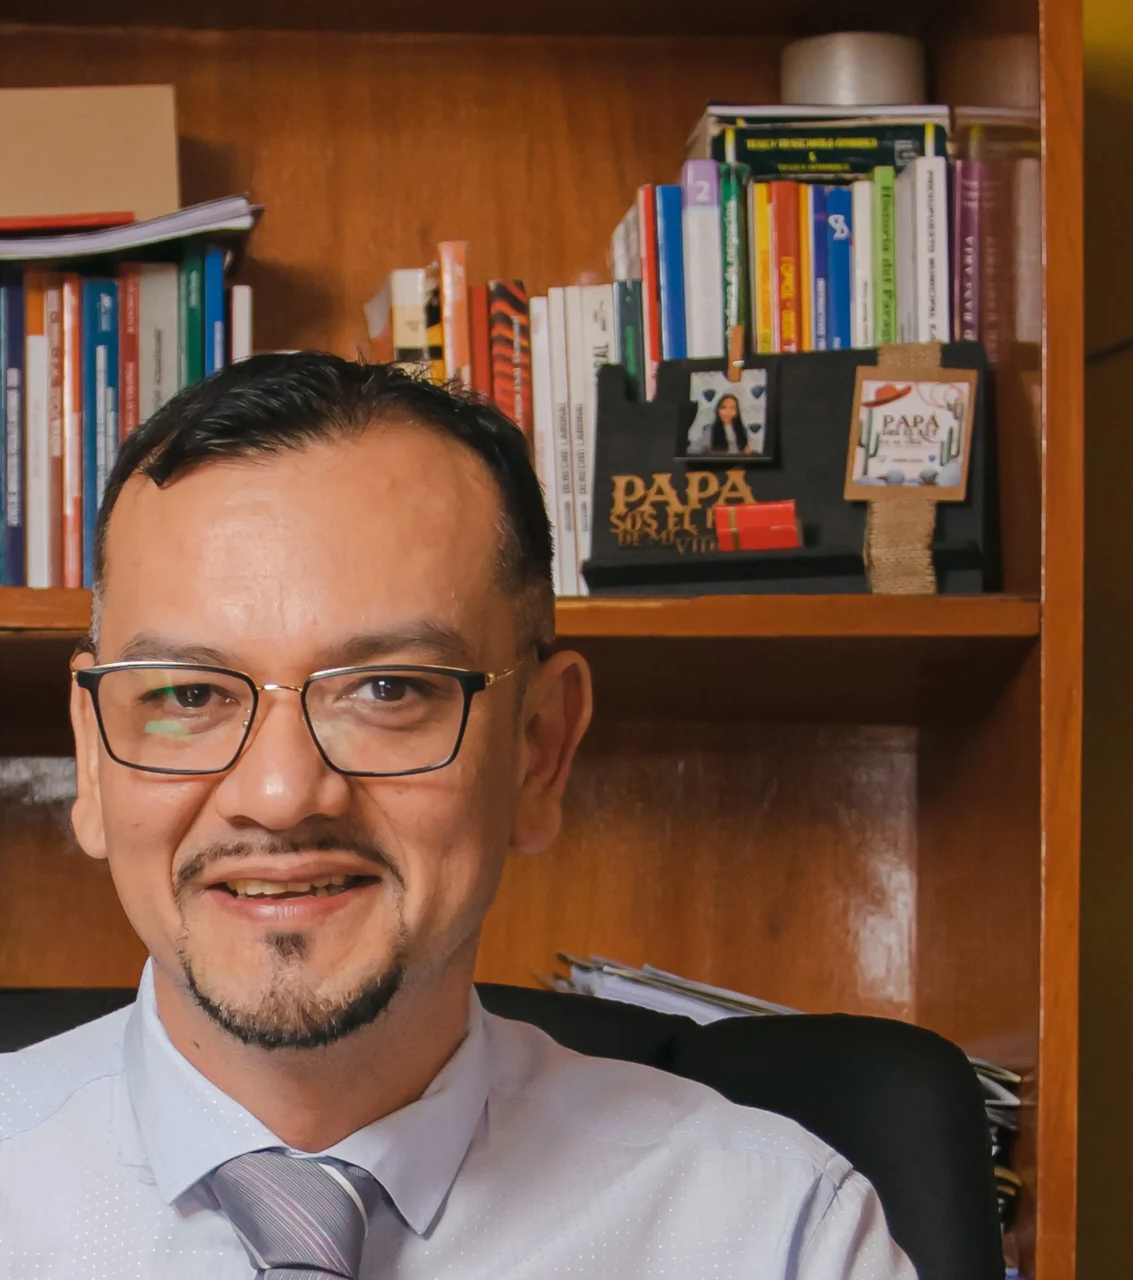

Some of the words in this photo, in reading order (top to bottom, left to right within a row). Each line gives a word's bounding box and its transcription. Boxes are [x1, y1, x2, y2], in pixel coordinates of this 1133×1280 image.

[696, 180, 711, 202] 2
[881, 185, 893, 252] Historia
[881, 258, 893, 282] del
[882, 411, 940, 430] PAPÁ
[609, 507, 659, 537] SOS
